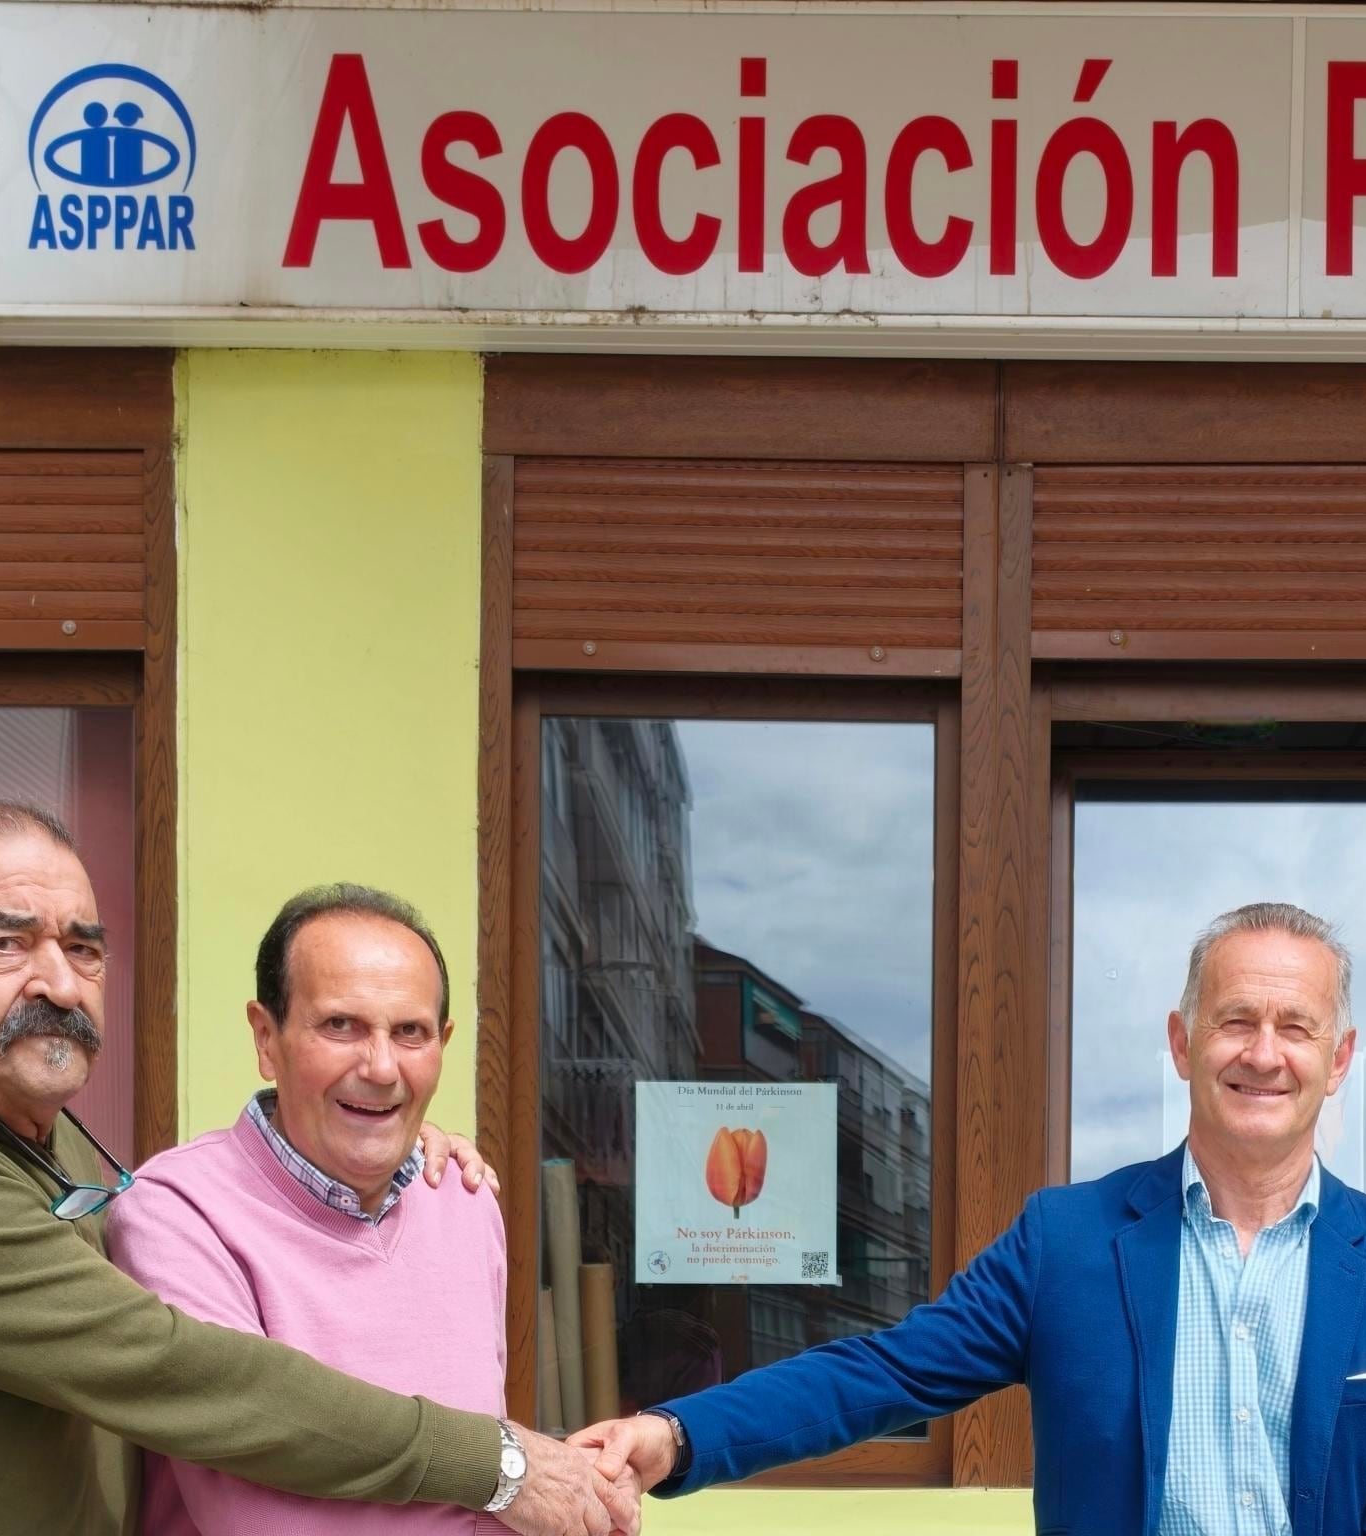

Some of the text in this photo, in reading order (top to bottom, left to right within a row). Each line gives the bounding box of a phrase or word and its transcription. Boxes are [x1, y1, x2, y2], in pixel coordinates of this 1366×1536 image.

[281, 52, 1239, 278] Asociación
[29, 193, 195, 250] ASPPAR
[697, 1086, 736, 1096] Mundial
[739, 1087, 753, 1096] del
[736, 1103, 754, 1111] abril
[677, 1227, 796, 1242] No soy Párkinson,
[691, 1243, 776, 1253] la discriminación
[702, 1254, 732, 1267] puede
